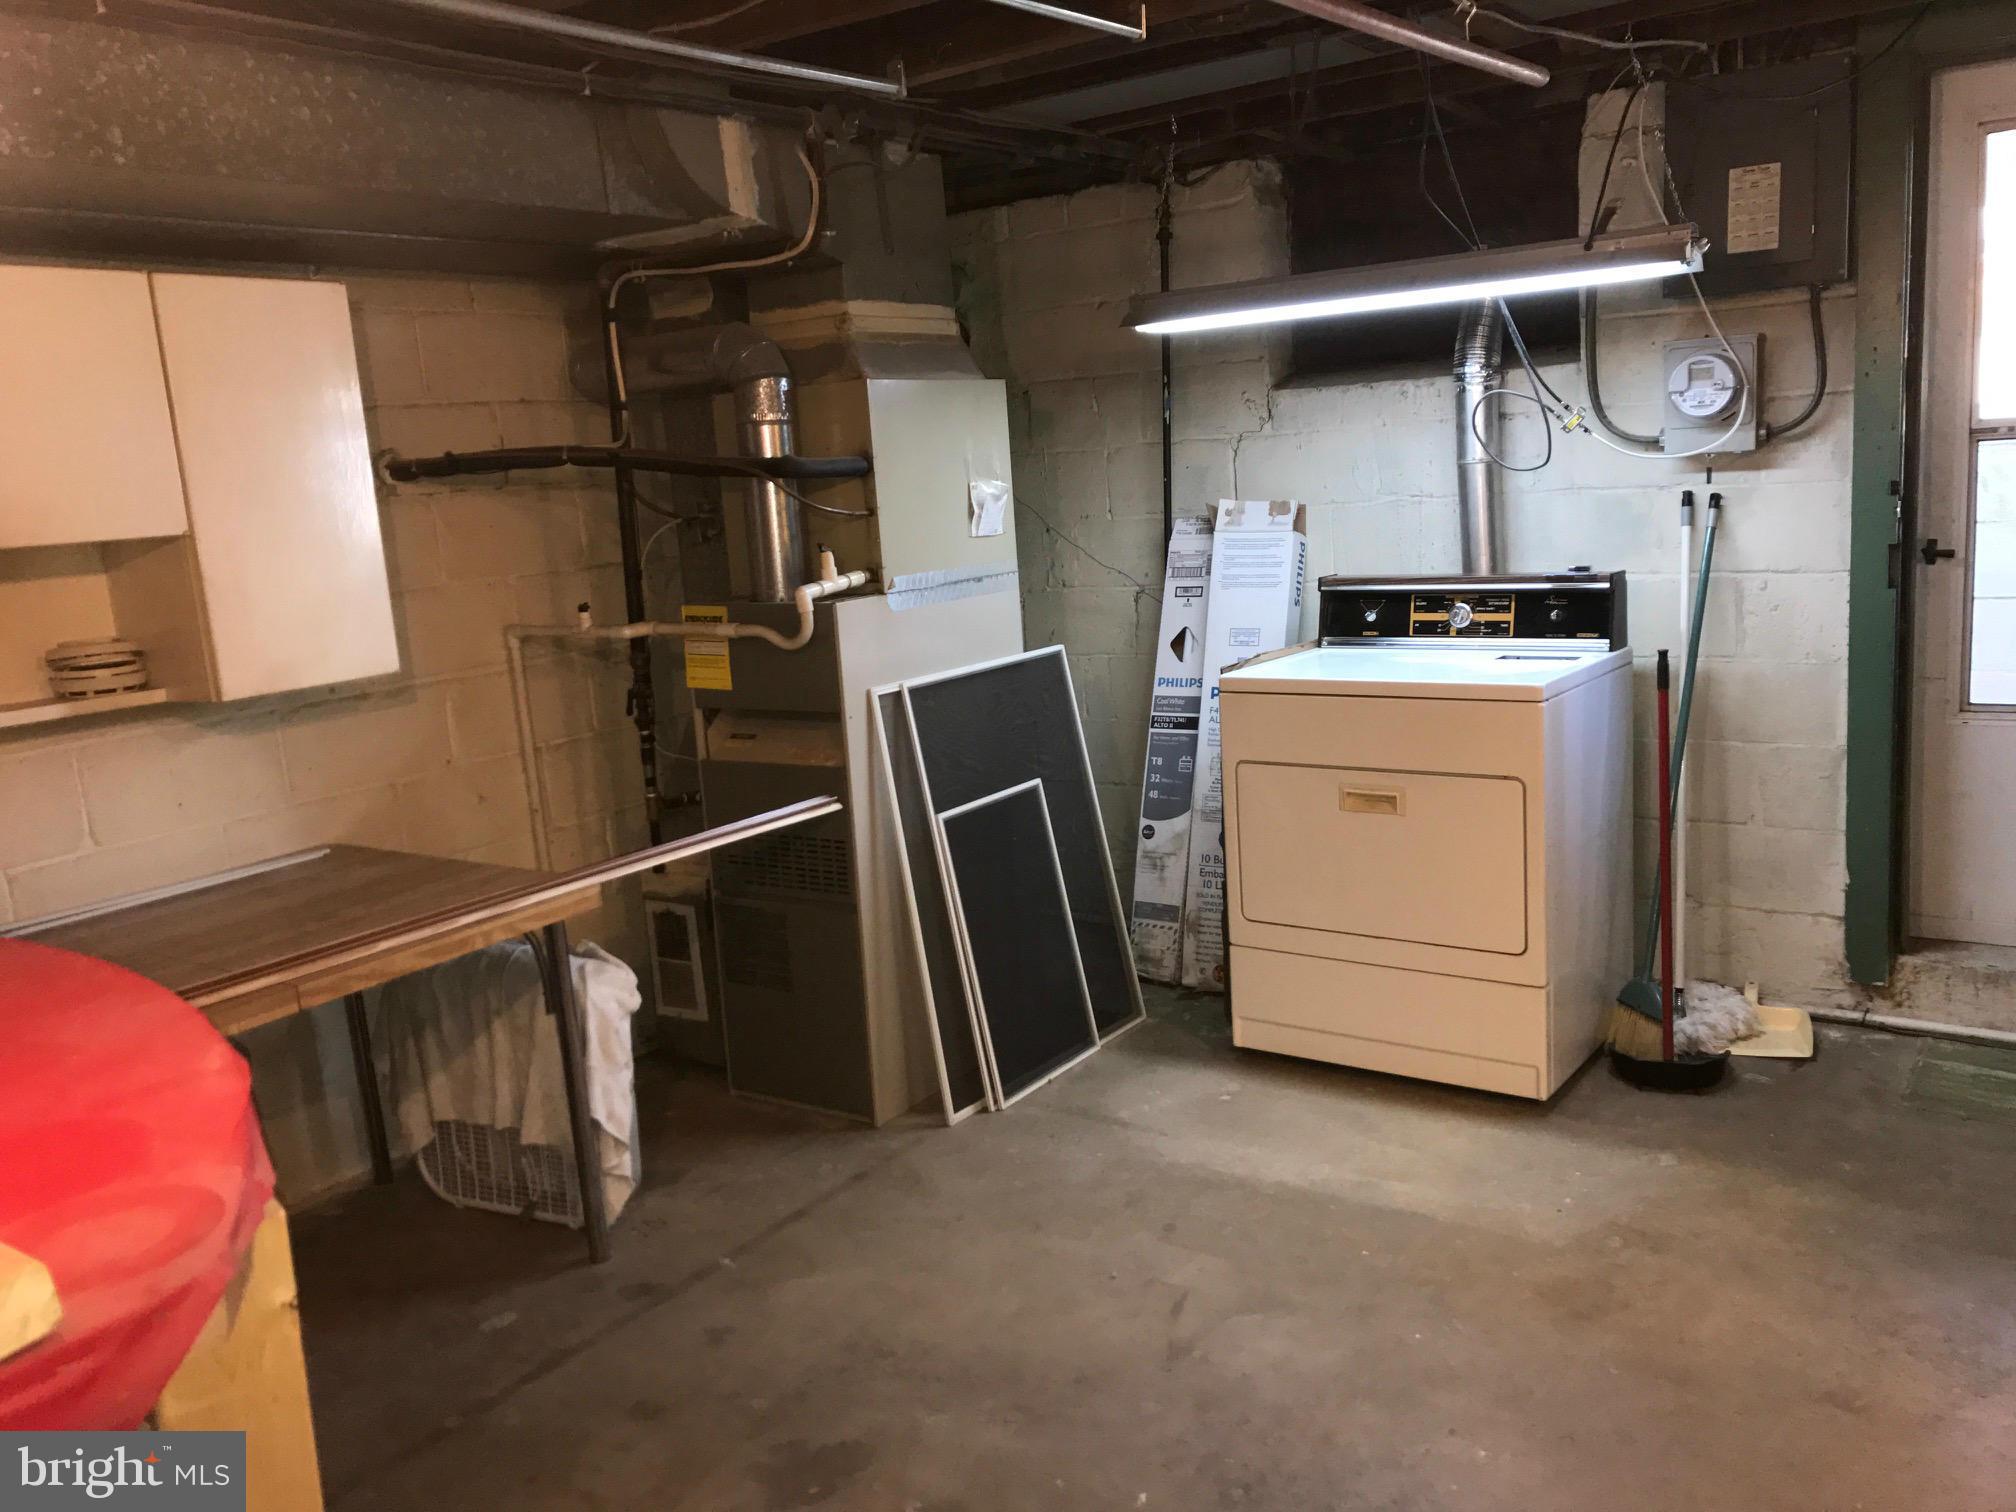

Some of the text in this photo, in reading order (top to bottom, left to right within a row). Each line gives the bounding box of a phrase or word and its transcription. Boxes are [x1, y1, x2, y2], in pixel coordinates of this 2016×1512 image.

[1294, 541, 1306, 607] PHILIPS
[1157, 677, 1203, 688] PHILIPS
[1168, 697, 1186, 706] White
[1150, 756, 1163, 766] T8
[1150, 773, 1161, 783] 32
[1148, 789, 1159, 799] 48
[1201, 854, 1211, 864] 10
